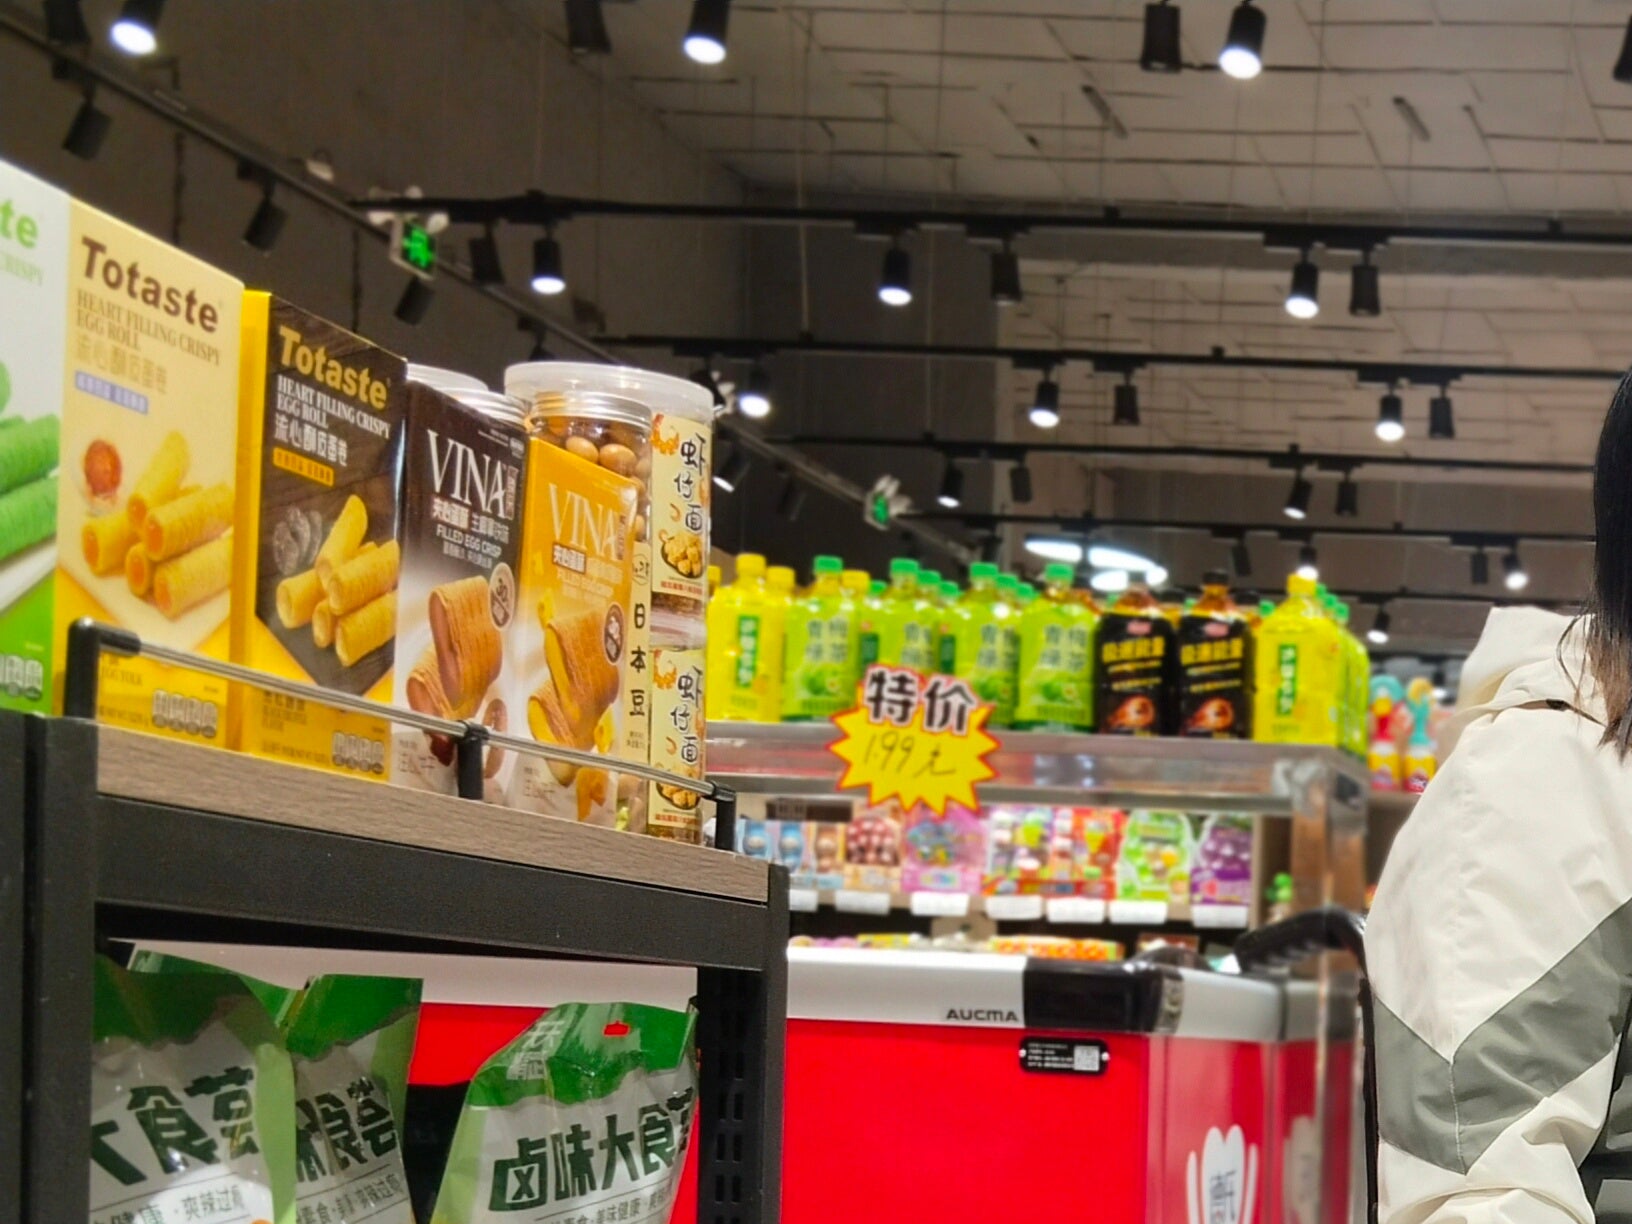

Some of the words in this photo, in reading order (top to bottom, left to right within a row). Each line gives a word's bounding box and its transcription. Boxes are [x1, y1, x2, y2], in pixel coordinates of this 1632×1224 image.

[81, 235, 219, 333] Totaste
[76, 308, 104, 333] EGG
[107, 323, 141, 350] ROLL
[77, 288, 123, 325] HEART
[126, 309, 177, 348] FILLING
[178, 331, 220, 367] CRISPY
[279, 325, 388, 410] Totaste
[276, 392, 301, 418] EGG
[301, 403, 329, 430] ROLL
[277, 374, 316, 405] HEART
[316, 390, 355, 425] FILLING
[355, 407, 391, 439] CRISPY
[427, 428, 505, 519] VINA
[674, 433, 706, 531] 虾仔面
[549, 482, 621, 562] VINA
[630, 603, 647, 716] 日本豆
[670, 665, 703, 763] 虾仔面
[866, 670, 975, 732] 特价
[946, 1008, 1019, 1023] AUCMA
